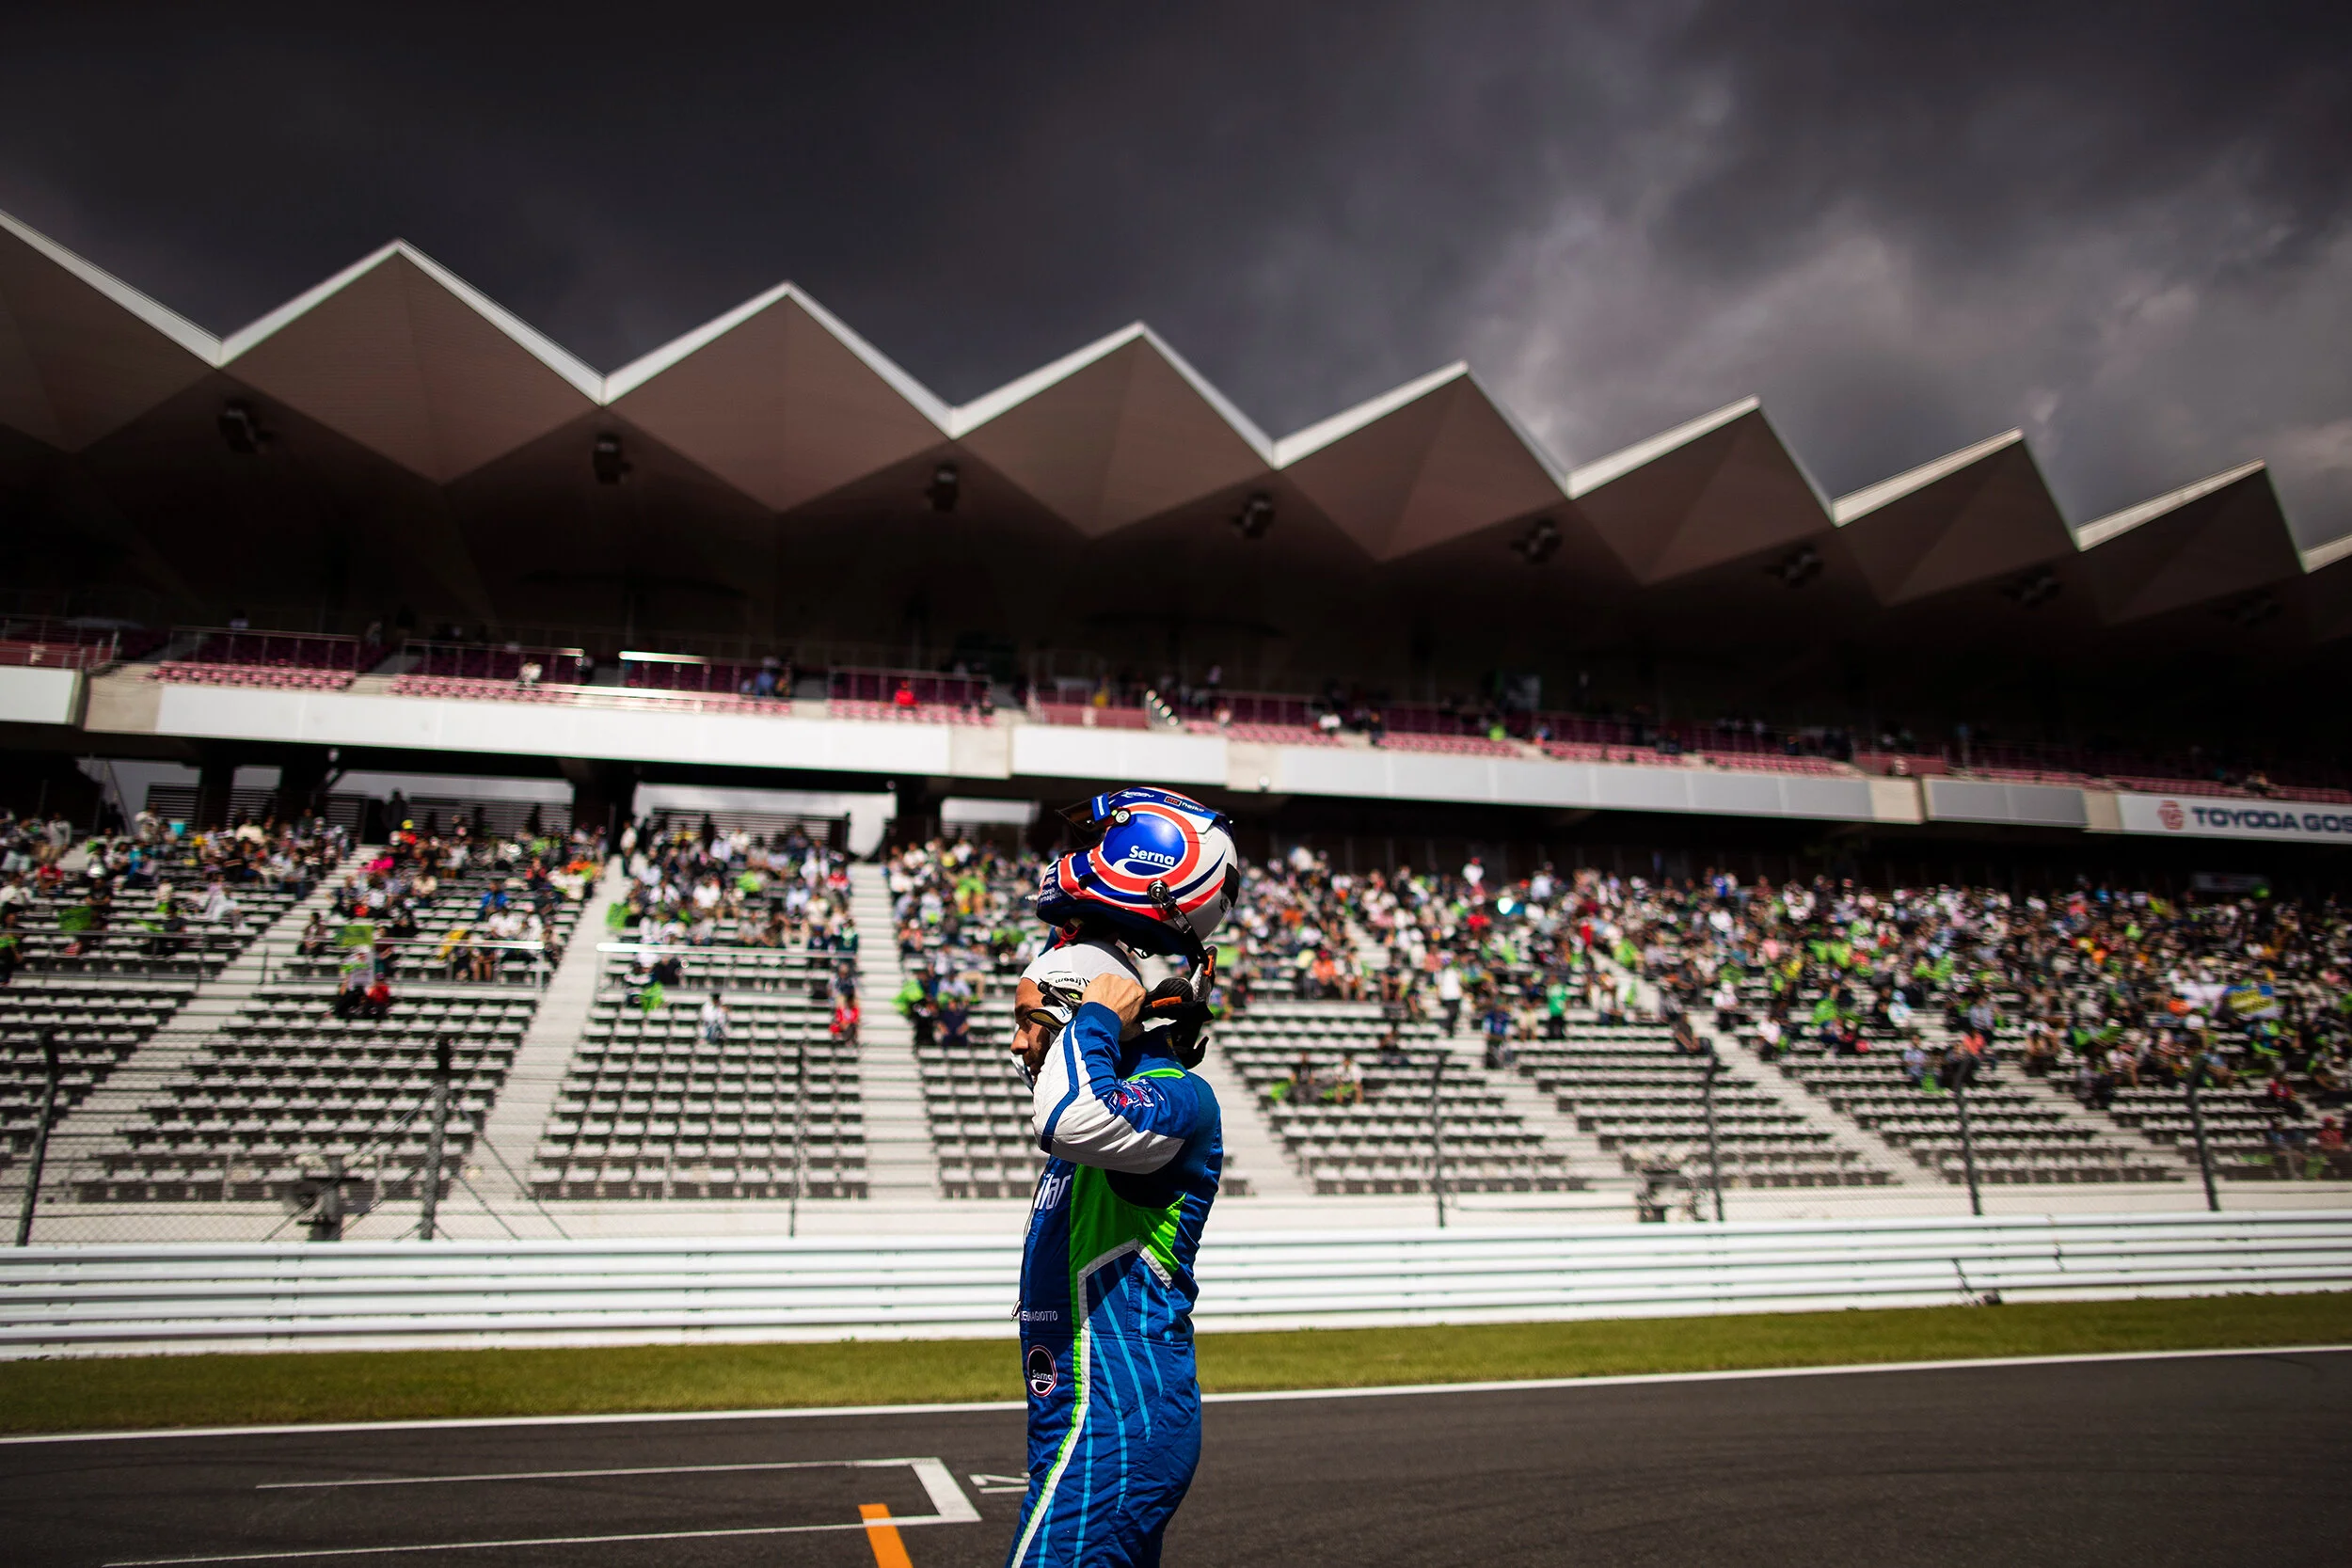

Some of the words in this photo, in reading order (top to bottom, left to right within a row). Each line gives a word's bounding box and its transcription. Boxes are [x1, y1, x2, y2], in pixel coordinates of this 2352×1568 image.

[2191, 806, 2300, 831] TOYODA
[1129, 845, 1175, 866] Serna
[1032, 1370, 1054, 1381] Serna
